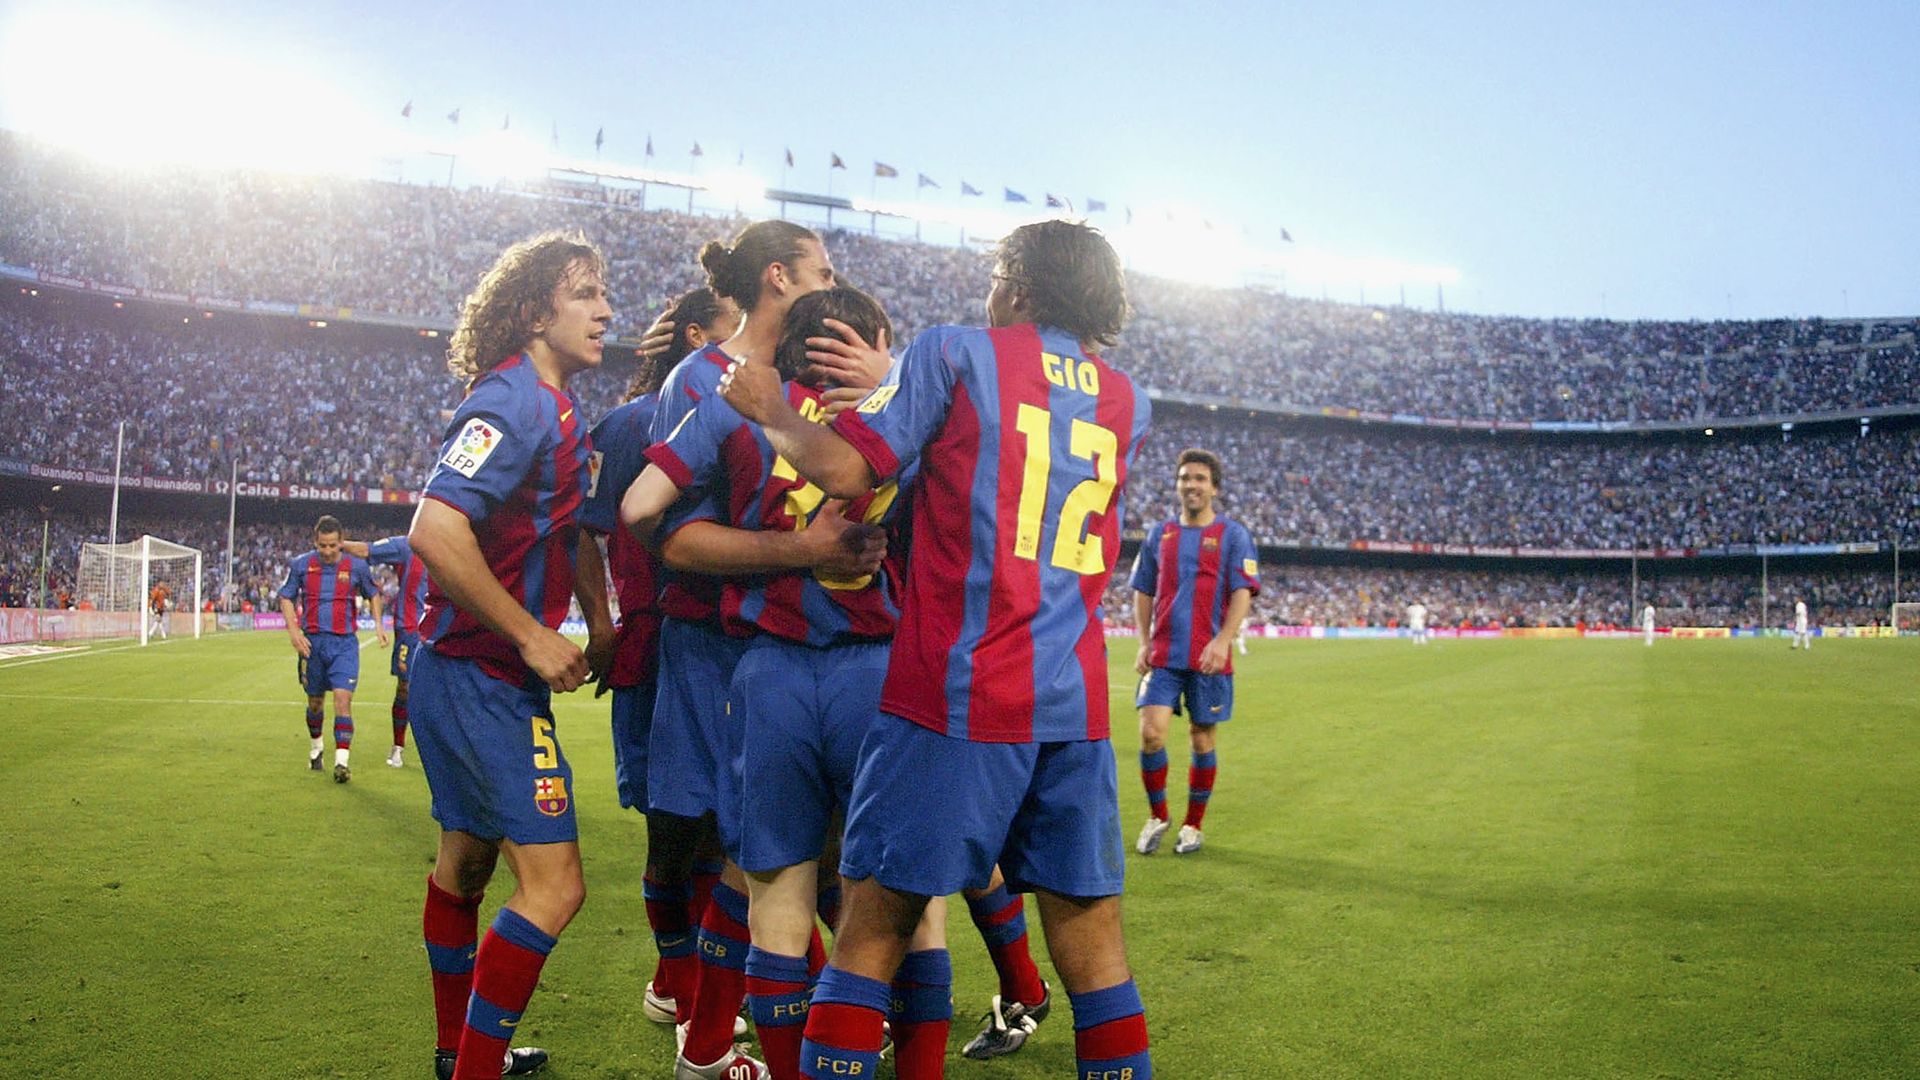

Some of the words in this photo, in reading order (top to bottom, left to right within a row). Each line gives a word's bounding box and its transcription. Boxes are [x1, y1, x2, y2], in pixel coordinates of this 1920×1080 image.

[1041, 352, 1100, 396] GIO
[445, 449, 475, 470] LFP
[40, 468, 84, 481] wanadoo
[154, 480, 202, 491] wanadoo
[235, 482, 280, 497] Caixa
[1014, 403, 1118, 576] 12
[531, 715, 558, 769] 5
[697, 935, 727, 957] FCB
[773, 999, 809, 1018] FCB
[817, 1055, 863, 1075] FCB
[1087, 1067, 1134, 1080] FCB
